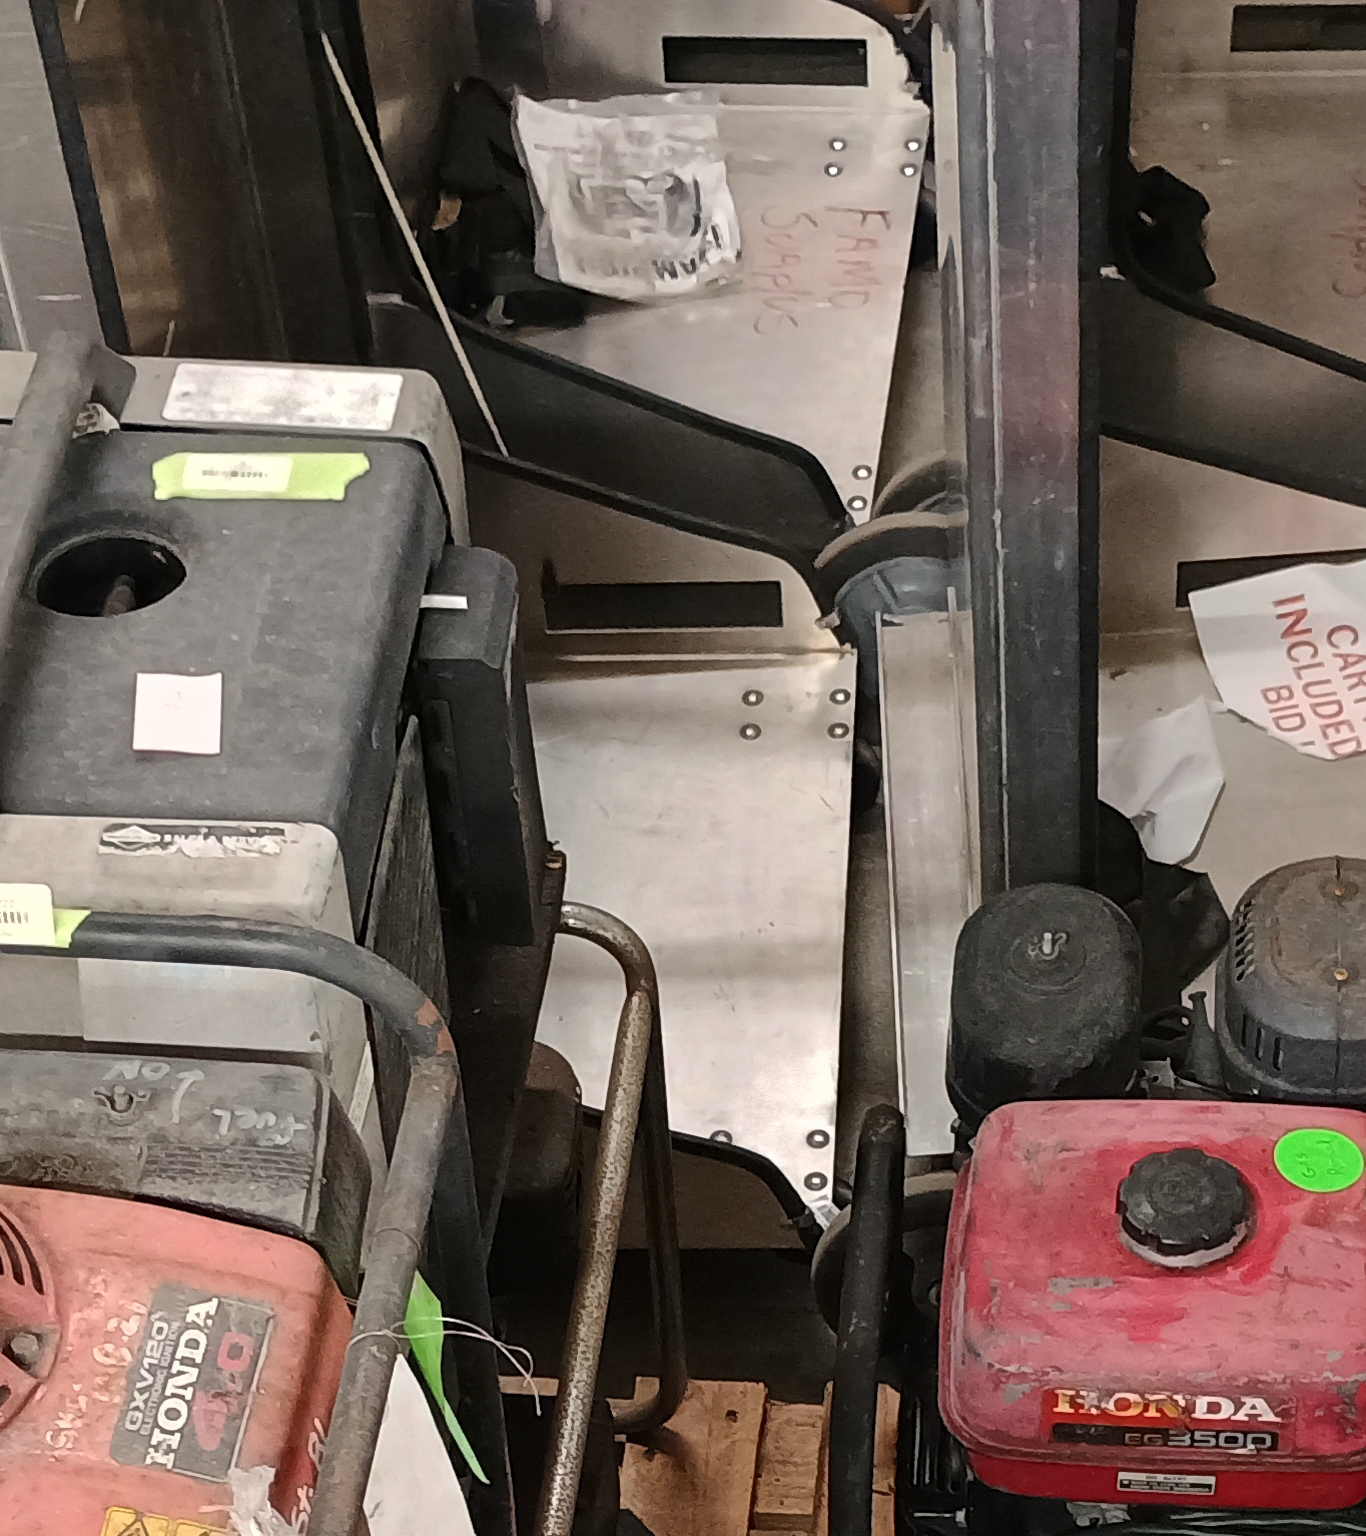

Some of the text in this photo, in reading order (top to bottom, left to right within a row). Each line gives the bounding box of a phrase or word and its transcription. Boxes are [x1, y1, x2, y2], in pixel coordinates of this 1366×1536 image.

[1261, 684, 1307, 733] BID
[1272, 593, 1362, 760] INCLUDED
[125, 1320, 169, 1432] GXV120
[145, 1298, 219, 1470] HONDA
[1052, 1390, 1283, 1422] HONDA
